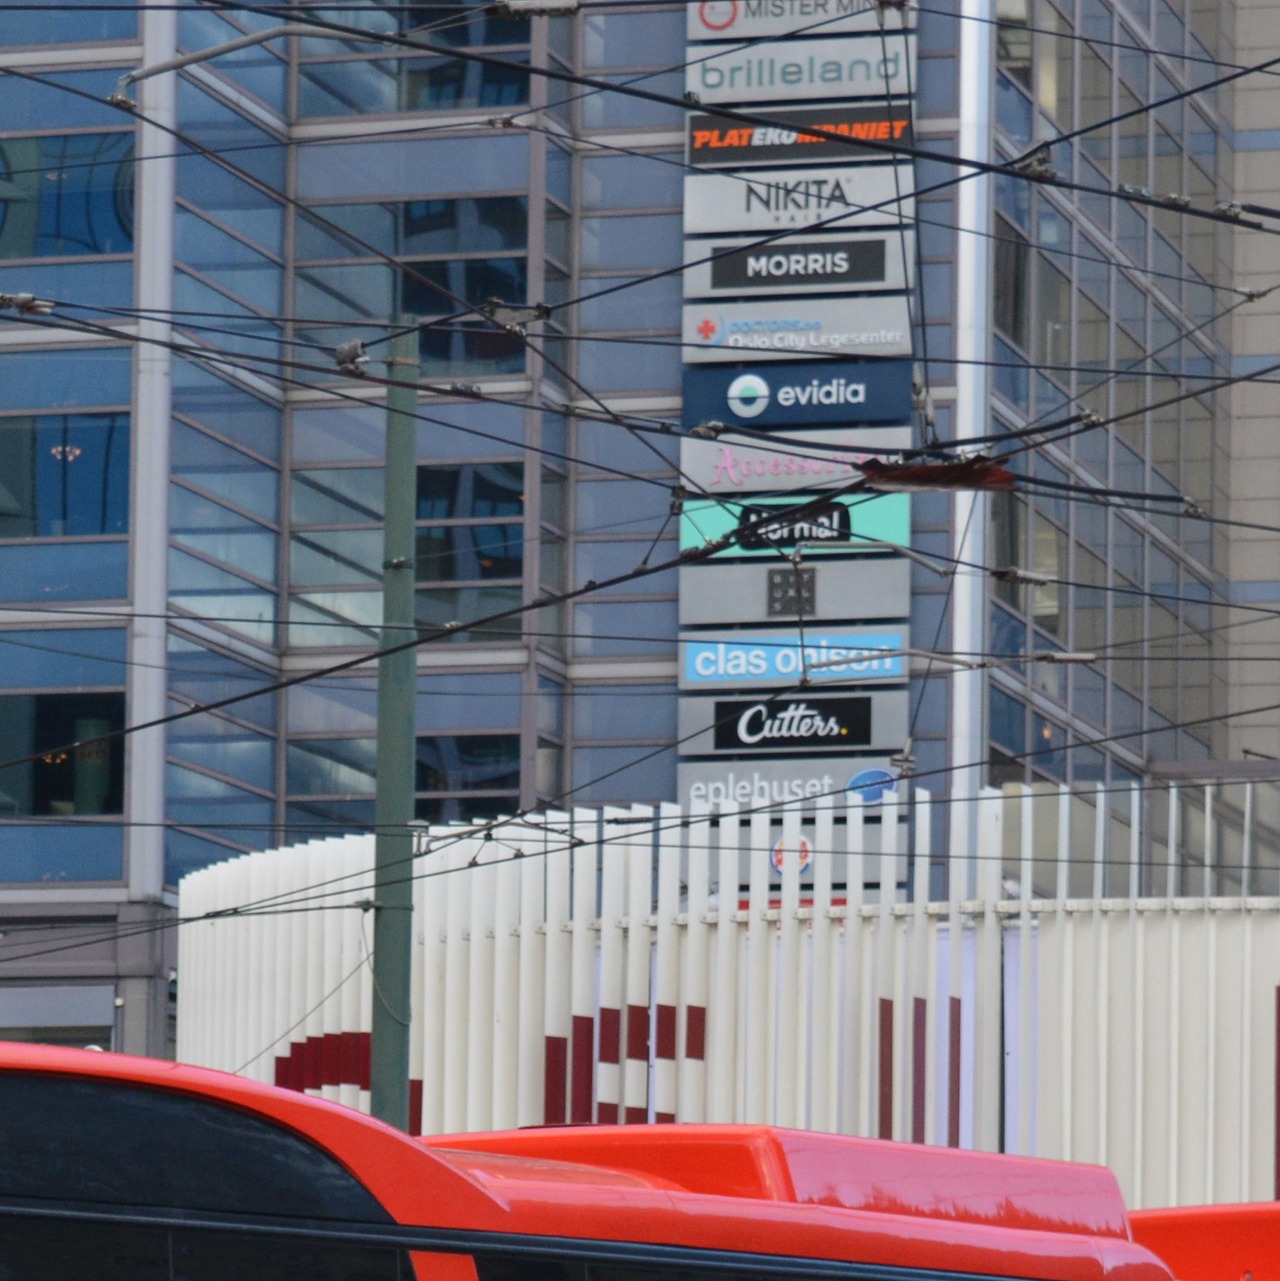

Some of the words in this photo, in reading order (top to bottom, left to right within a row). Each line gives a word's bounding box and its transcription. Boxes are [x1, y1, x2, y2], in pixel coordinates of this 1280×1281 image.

[701, 52, 900, 88] brilleland
[693, 121, 908, 149] PLATEKOMPANIET
[746, 178, 850, 212] NIKITA
[747, 252, 849, 277] MORRIS
[728, 334, 769, 348] Oslo
[773, 332, 806, 350] City
[809, 329, 903, 347] Legesenter
[777, 379, 866, 406] evidia
[695, 642, 768, 677] clas
[775, 640, 893, 674] ohlson
[689, 772, 834, 804] eplehuset
